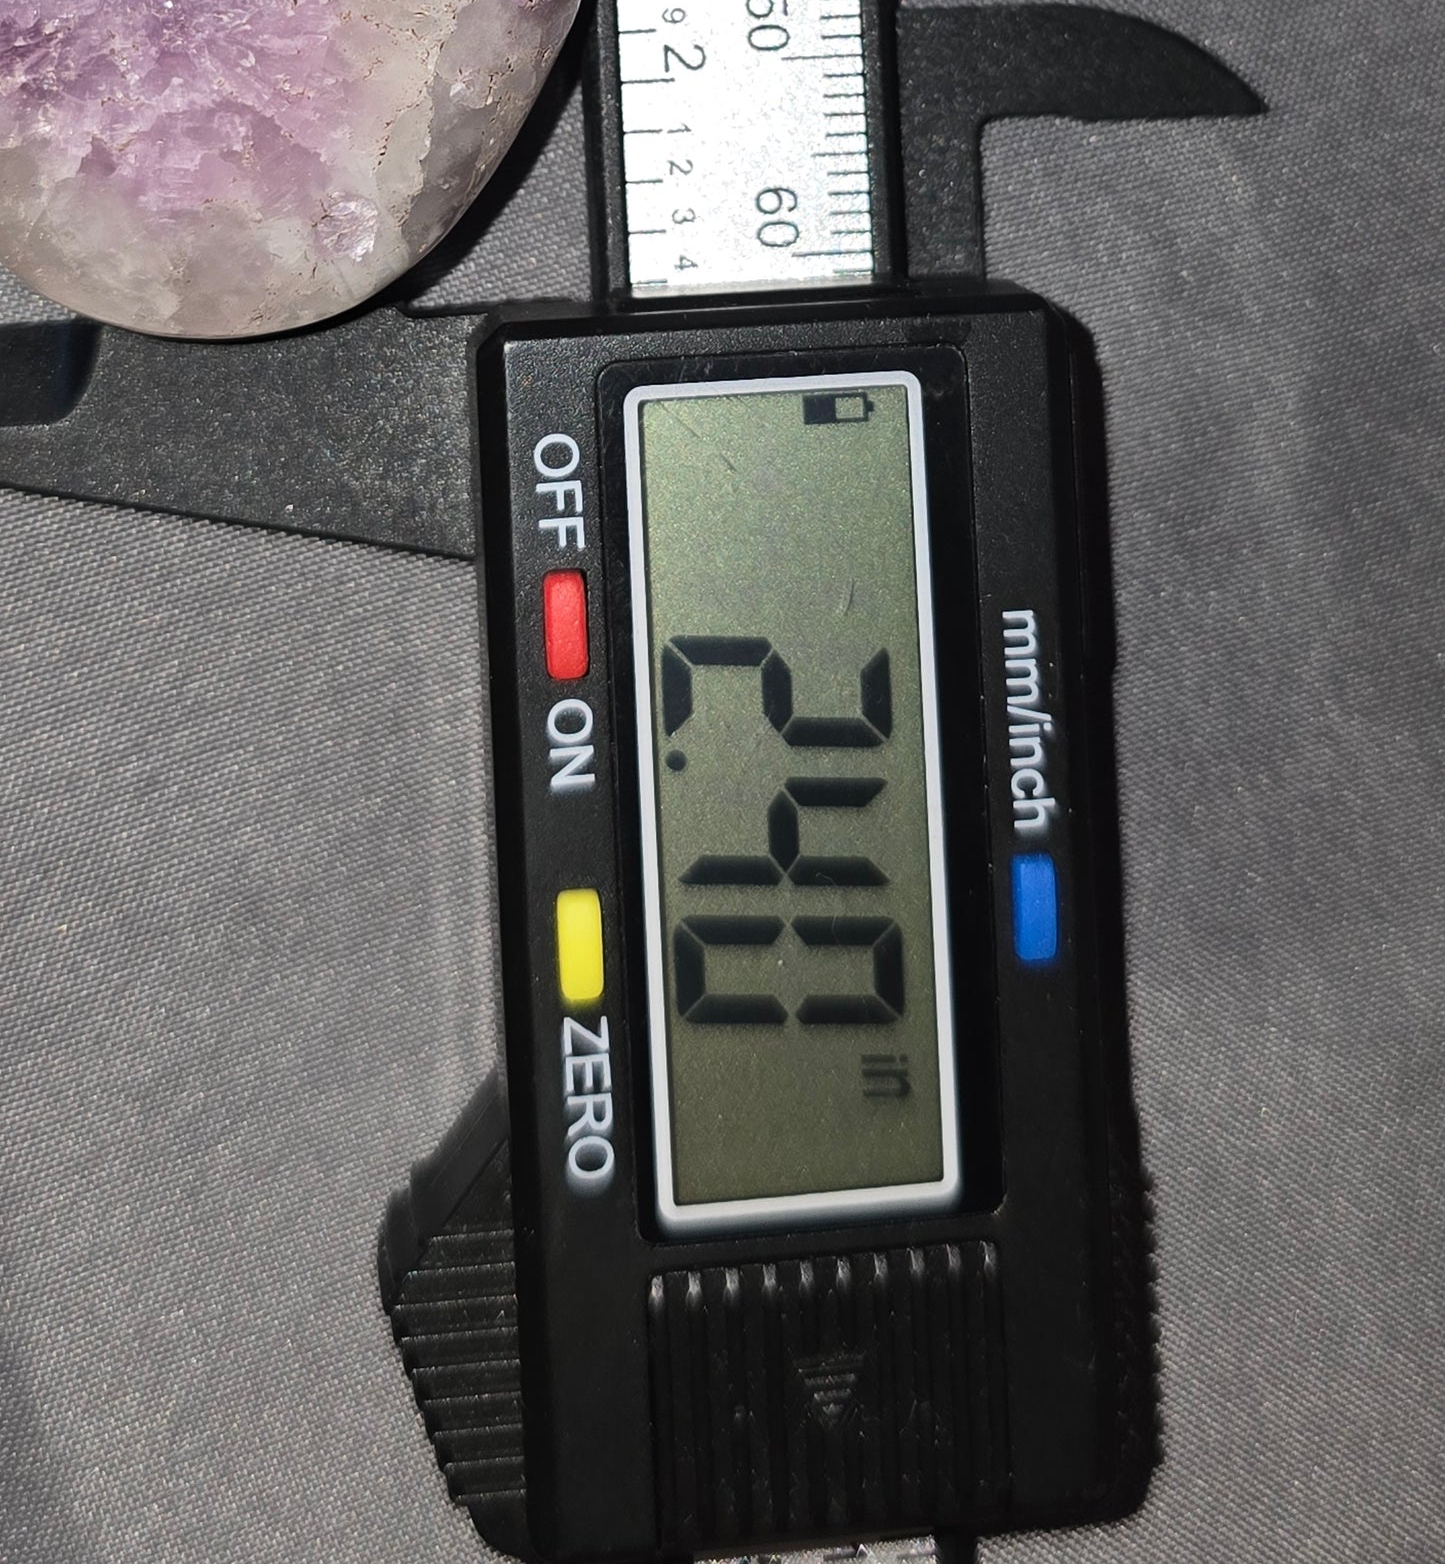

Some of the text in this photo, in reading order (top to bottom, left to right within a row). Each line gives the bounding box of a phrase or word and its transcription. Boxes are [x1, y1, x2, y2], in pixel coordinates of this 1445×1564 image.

[662, 7, 686, 24] 9
[663, 44, 706, 73] 2
[668, 159, 693, 176] 2
[672, 207, 697, 224] 3
[756, 186, 800, 248] 60
[674, 255, 698, 271] 4
[532, 432, 587, 551] OFF
[547, 698, 598, 789] ON
[1001, 608, 1058, 831] mm/inch
[661, 635, 911, 1099] 2.40 in
[559, 1014, 617, 1183] ZERO
